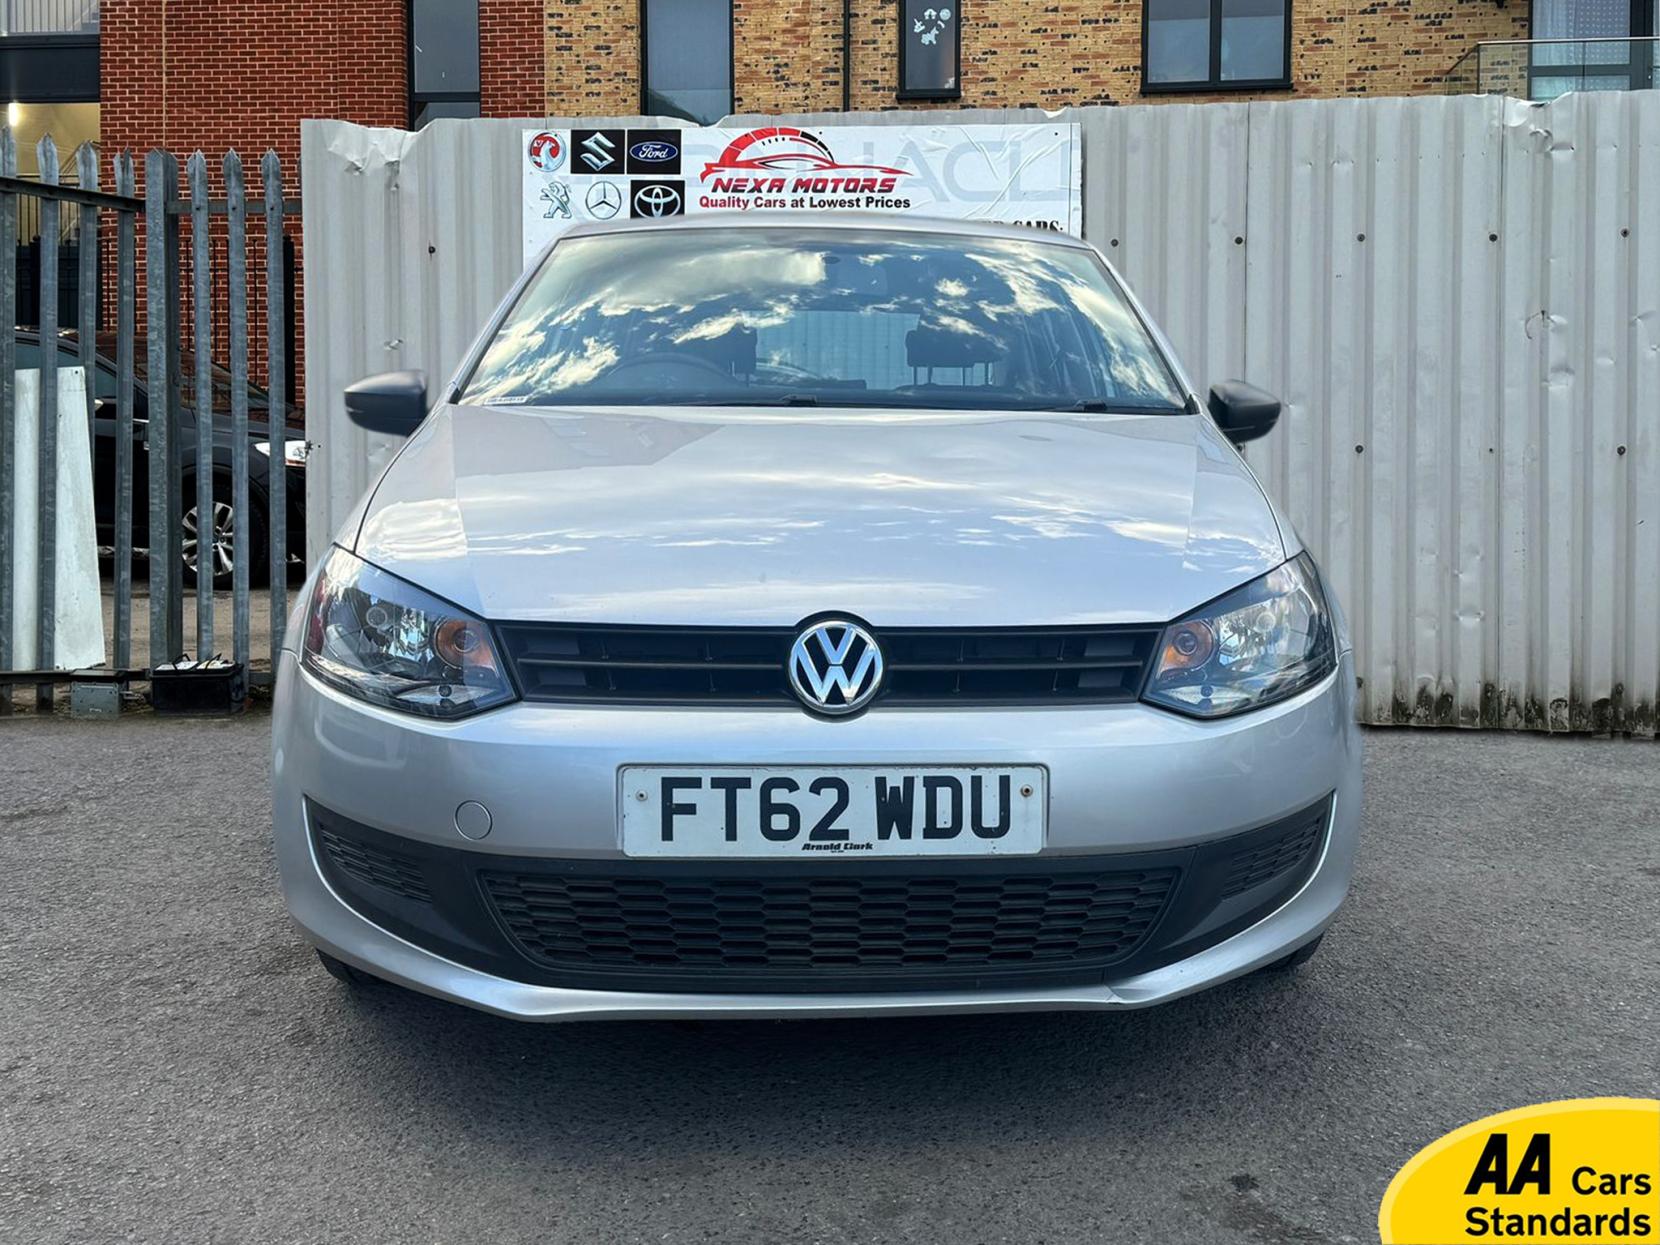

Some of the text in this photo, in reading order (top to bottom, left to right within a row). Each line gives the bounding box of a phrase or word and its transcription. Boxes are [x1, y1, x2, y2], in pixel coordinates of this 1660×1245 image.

[638, 144, 669, 159] Ford
[711, 178, 897, 194] NEXA MOTORS
[699, 196, 911, 210] Quality Cars at Lowest Prices
[661, 774, 1011, 842] FT62 WDU
[801, 842, 874, 851] Arnold Clark
